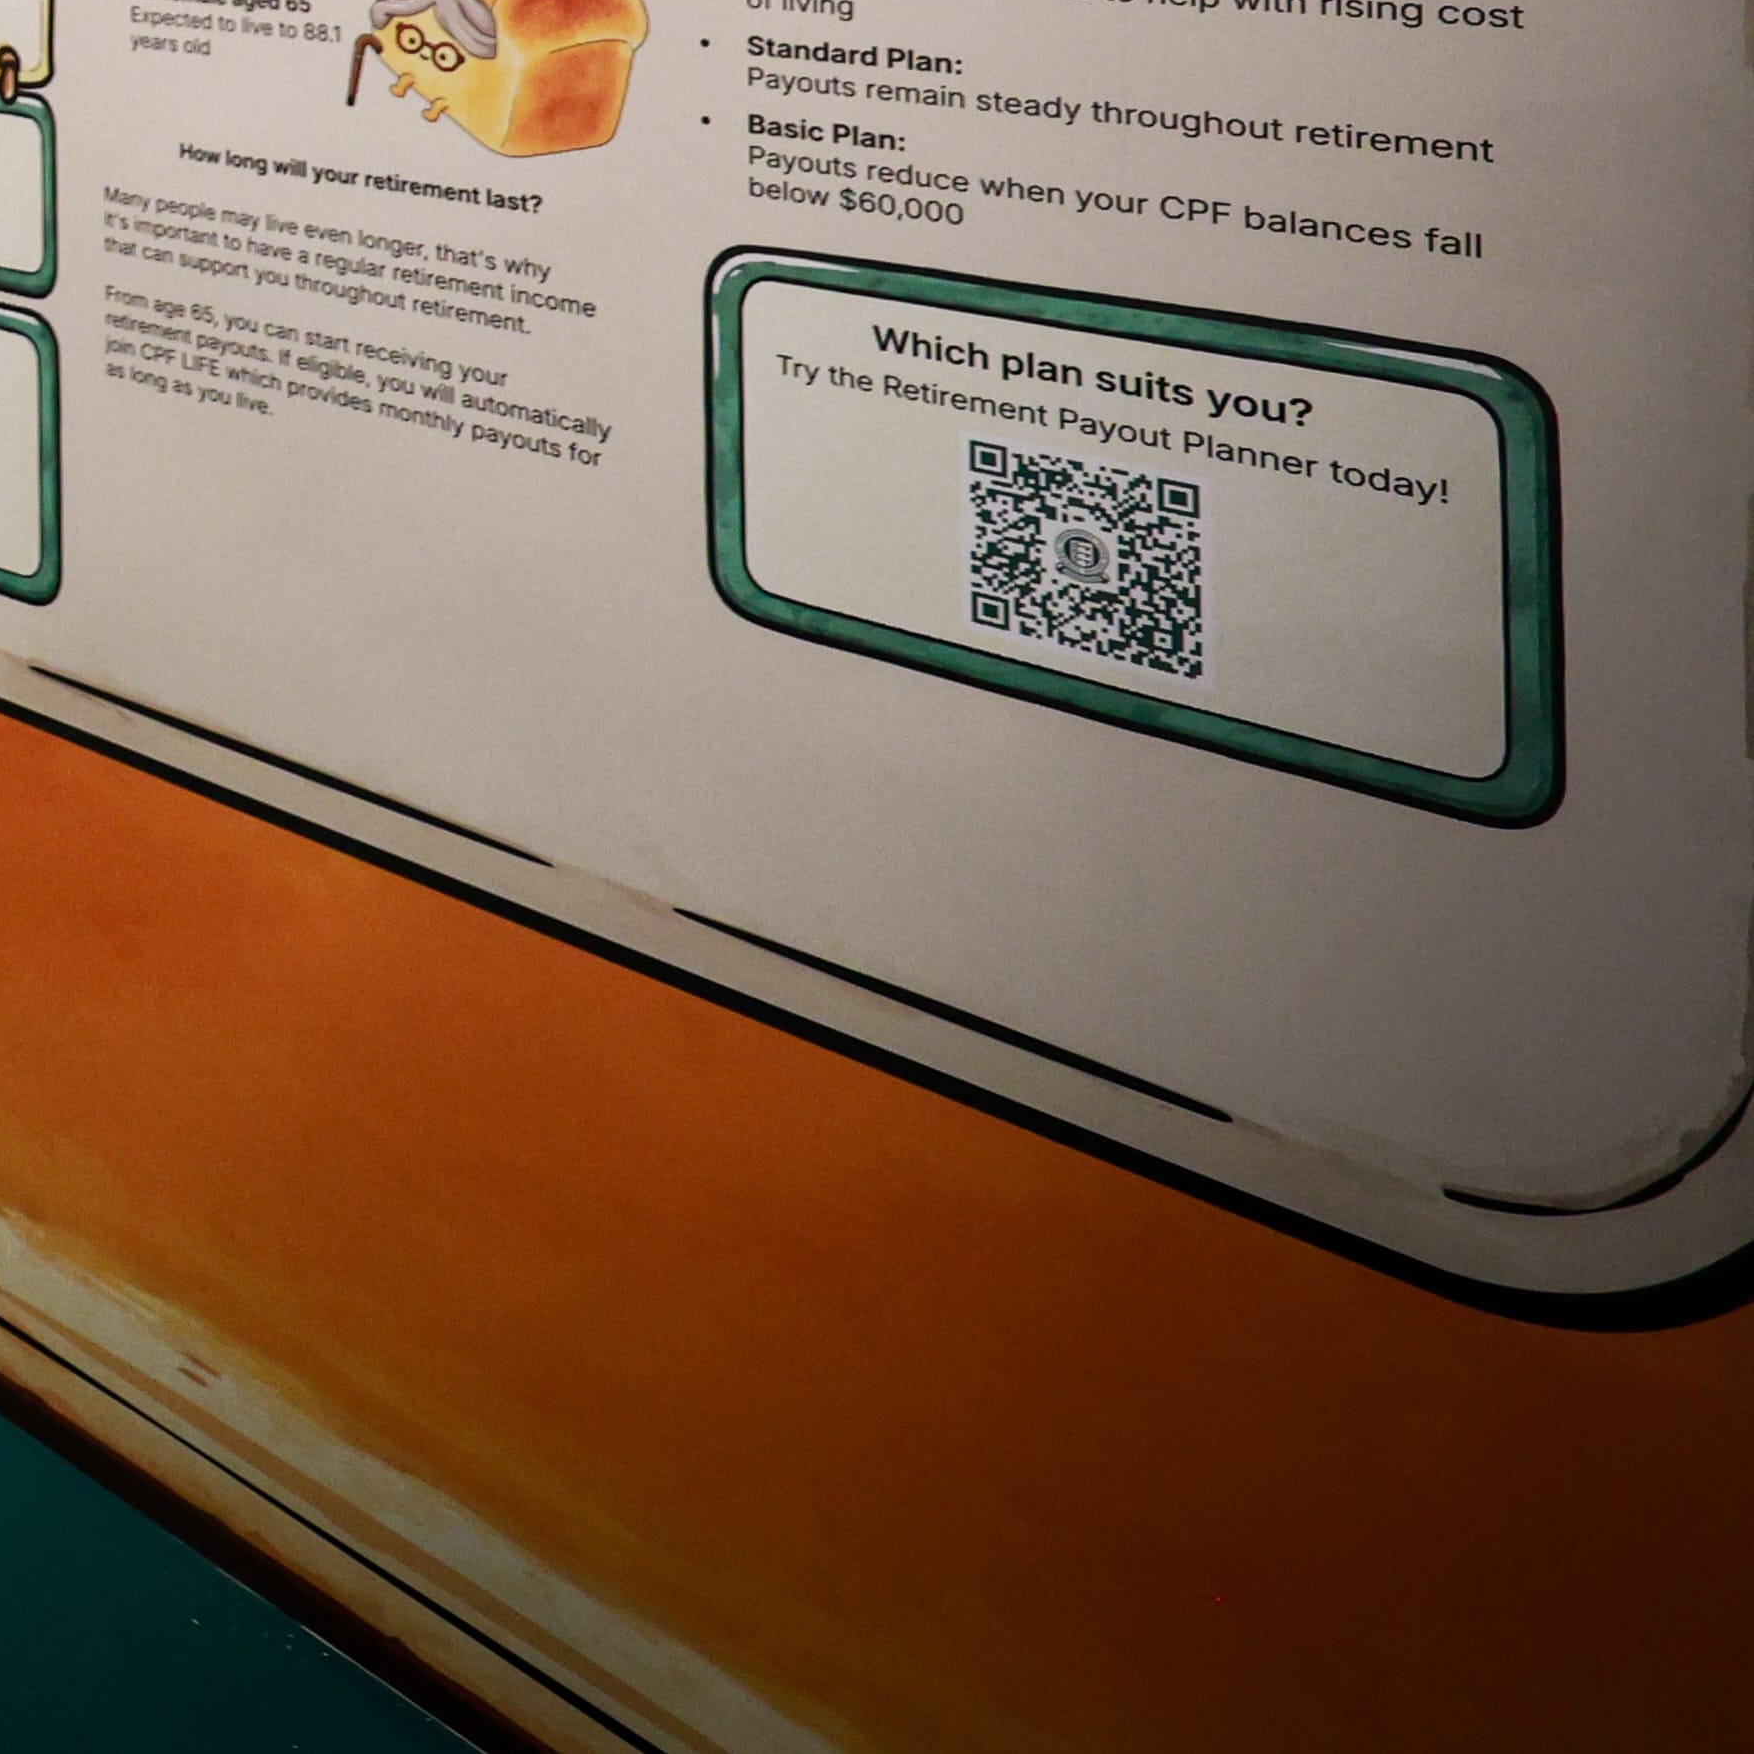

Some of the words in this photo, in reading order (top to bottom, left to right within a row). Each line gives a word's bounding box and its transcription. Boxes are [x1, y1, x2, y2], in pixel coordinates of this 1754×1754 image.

[747, 35, 877, 66] Standard
[887, 47, 961, 74] Plan:
[747, 66, 855, 97] Payouts
[866, 83, 964, 108] remain
[976, 92, 1081, 125] steady
[1091, 100, 1283, 141] throughout
[1295, 123, 1493, 163] retirement
[748, 113, 823, 141] Basic
[832, 123, 904, 151] Plan:
[179, 143, 220, 163] How
[225, 149, 267, 176] long
[273, 159, 306, 177] will
[311, 167, 358, 184] your
[364, 173, 480, 204] retirement
[486, 188, 542, 213] last?
[749, 176, 829, 206] below
[839, 187, 963, 225] $60,000
[872, 324, 988, 369] Which
[1001, 351, 1082, 386] plan
[1095, 370, 1193, 405] suits
[1206, 389, 1312, 426] you?
[776, 354, 819, 385] Try
[827, 366, 872, 391] the
[883, 374, 1047, 426] Retirement
[1059, 407, 1171, 450] Payout
[1183, 430, 1318, 477] Planner
[1329, 460, 1448, 505] today!
